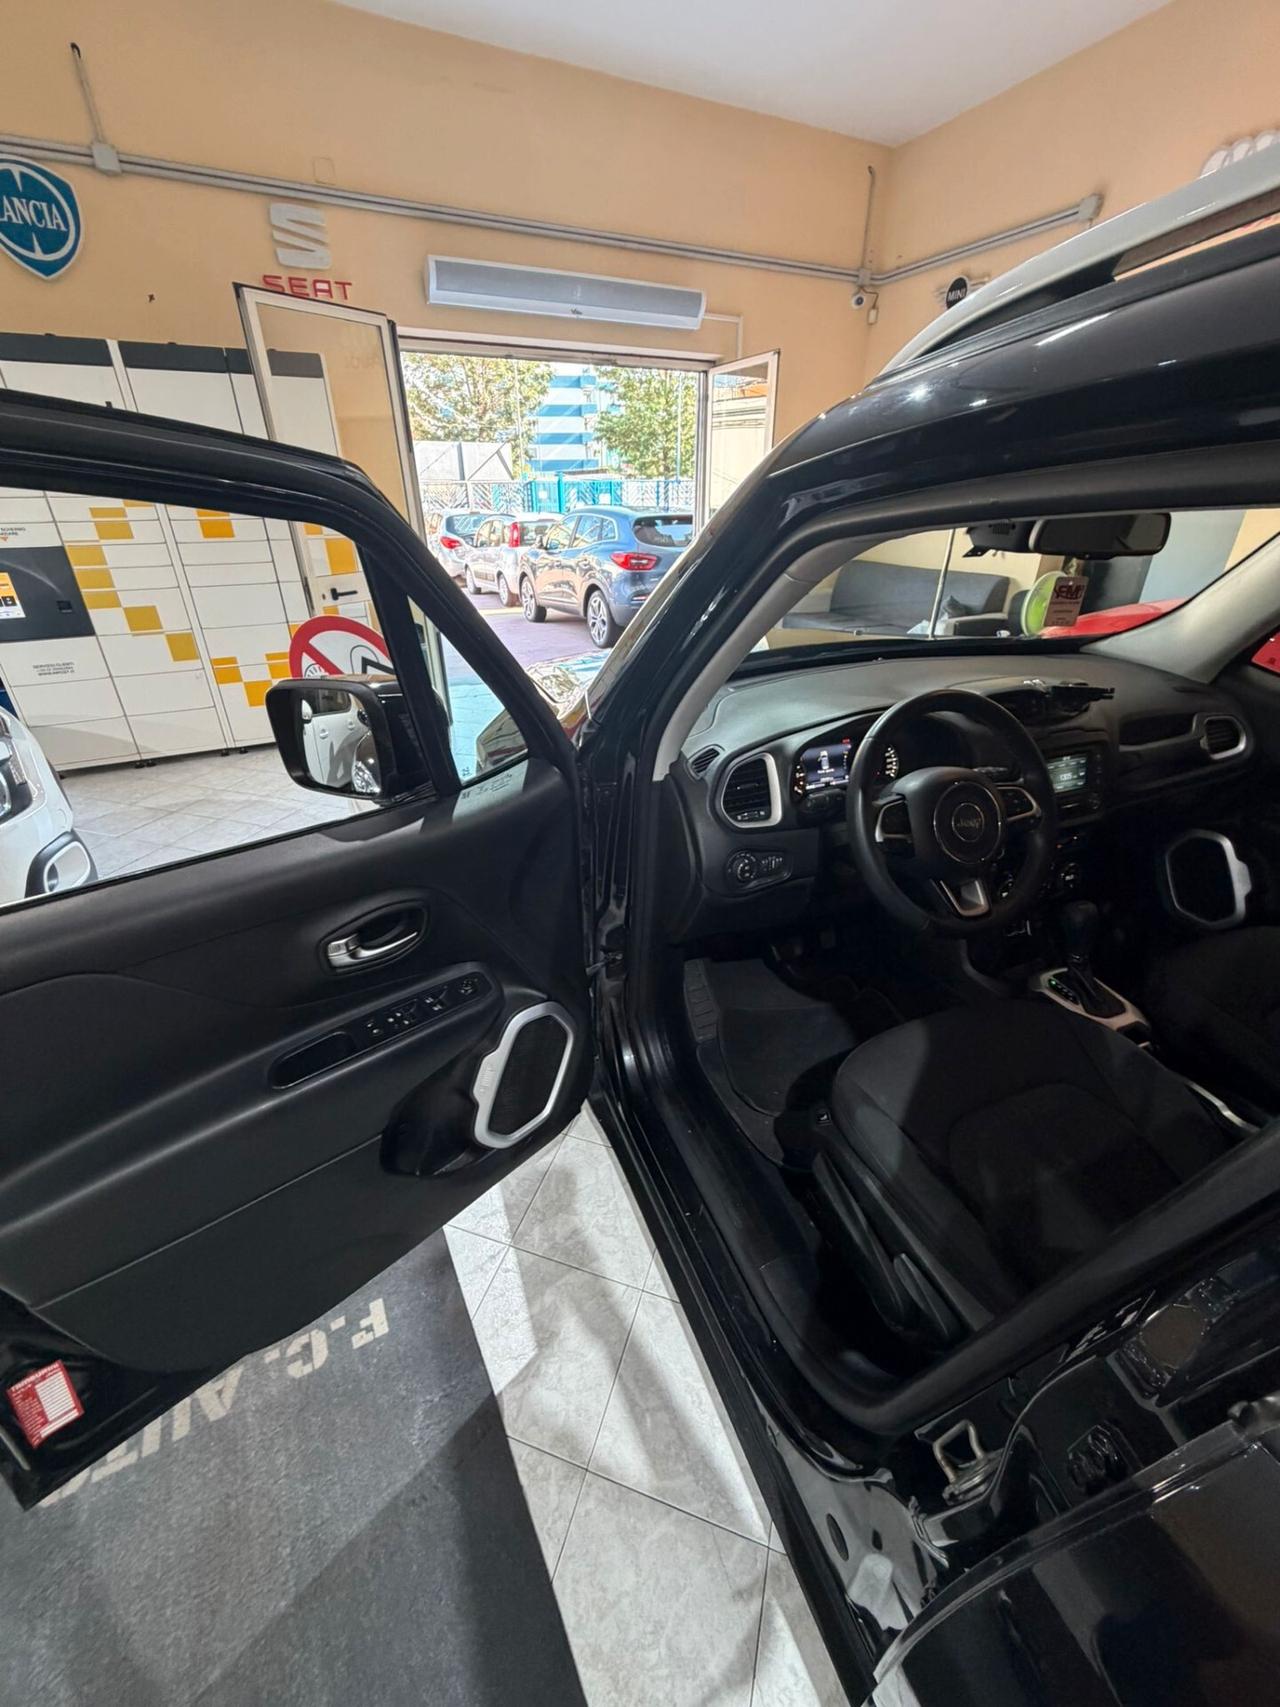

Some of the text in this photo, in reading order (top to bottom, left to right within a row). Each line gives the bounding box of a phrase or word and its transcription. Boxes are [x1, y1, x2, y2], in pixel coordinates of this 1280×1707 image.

[0, 194, 68, 232] ANCIA
[262, 274, 353, 301] SEAT
[947, 287, 967, 302] MINI
[38, 1366, 244, 1508] AUT
